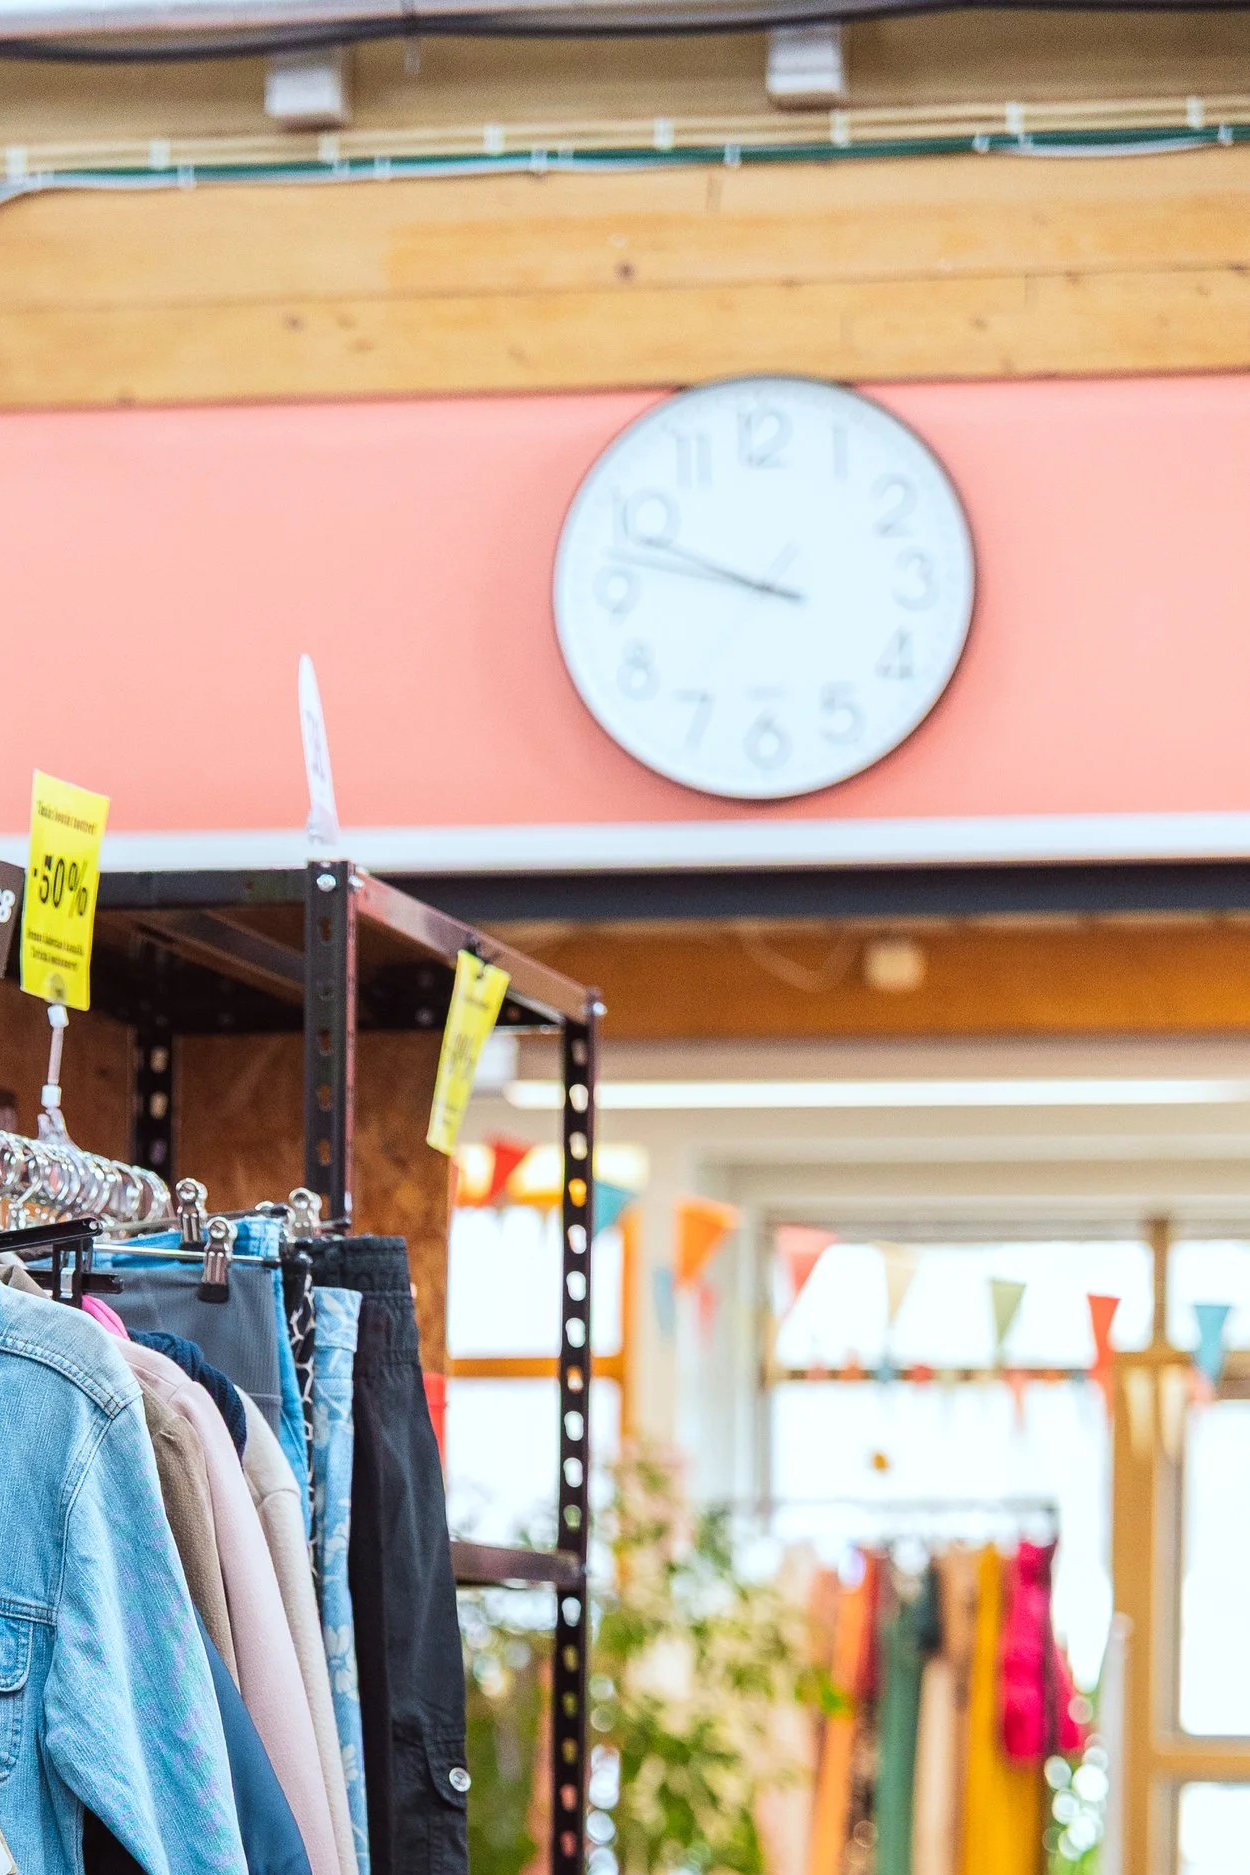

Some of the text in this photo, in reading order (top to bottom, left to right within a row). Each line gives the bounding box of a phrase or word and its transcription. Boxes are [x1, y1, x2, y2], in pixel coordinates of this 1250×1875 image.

[661, 418, 713, 490] 11
[737, 405, 795, 470] 12
[830, 417, 851, 484] 1
[607, 484, 683, 549] 10
[870, 471, 919, 540] 2
[592, 562, 642, 628] 9
[890, 545, 941, 613] 3
[616, 637, 661, 702] 8
[873, 624, 917, 681] 4
[669, 686, 717, 757] 7
[742, 703, 794, 772] 6
[817, 678, 868, 746] 5
